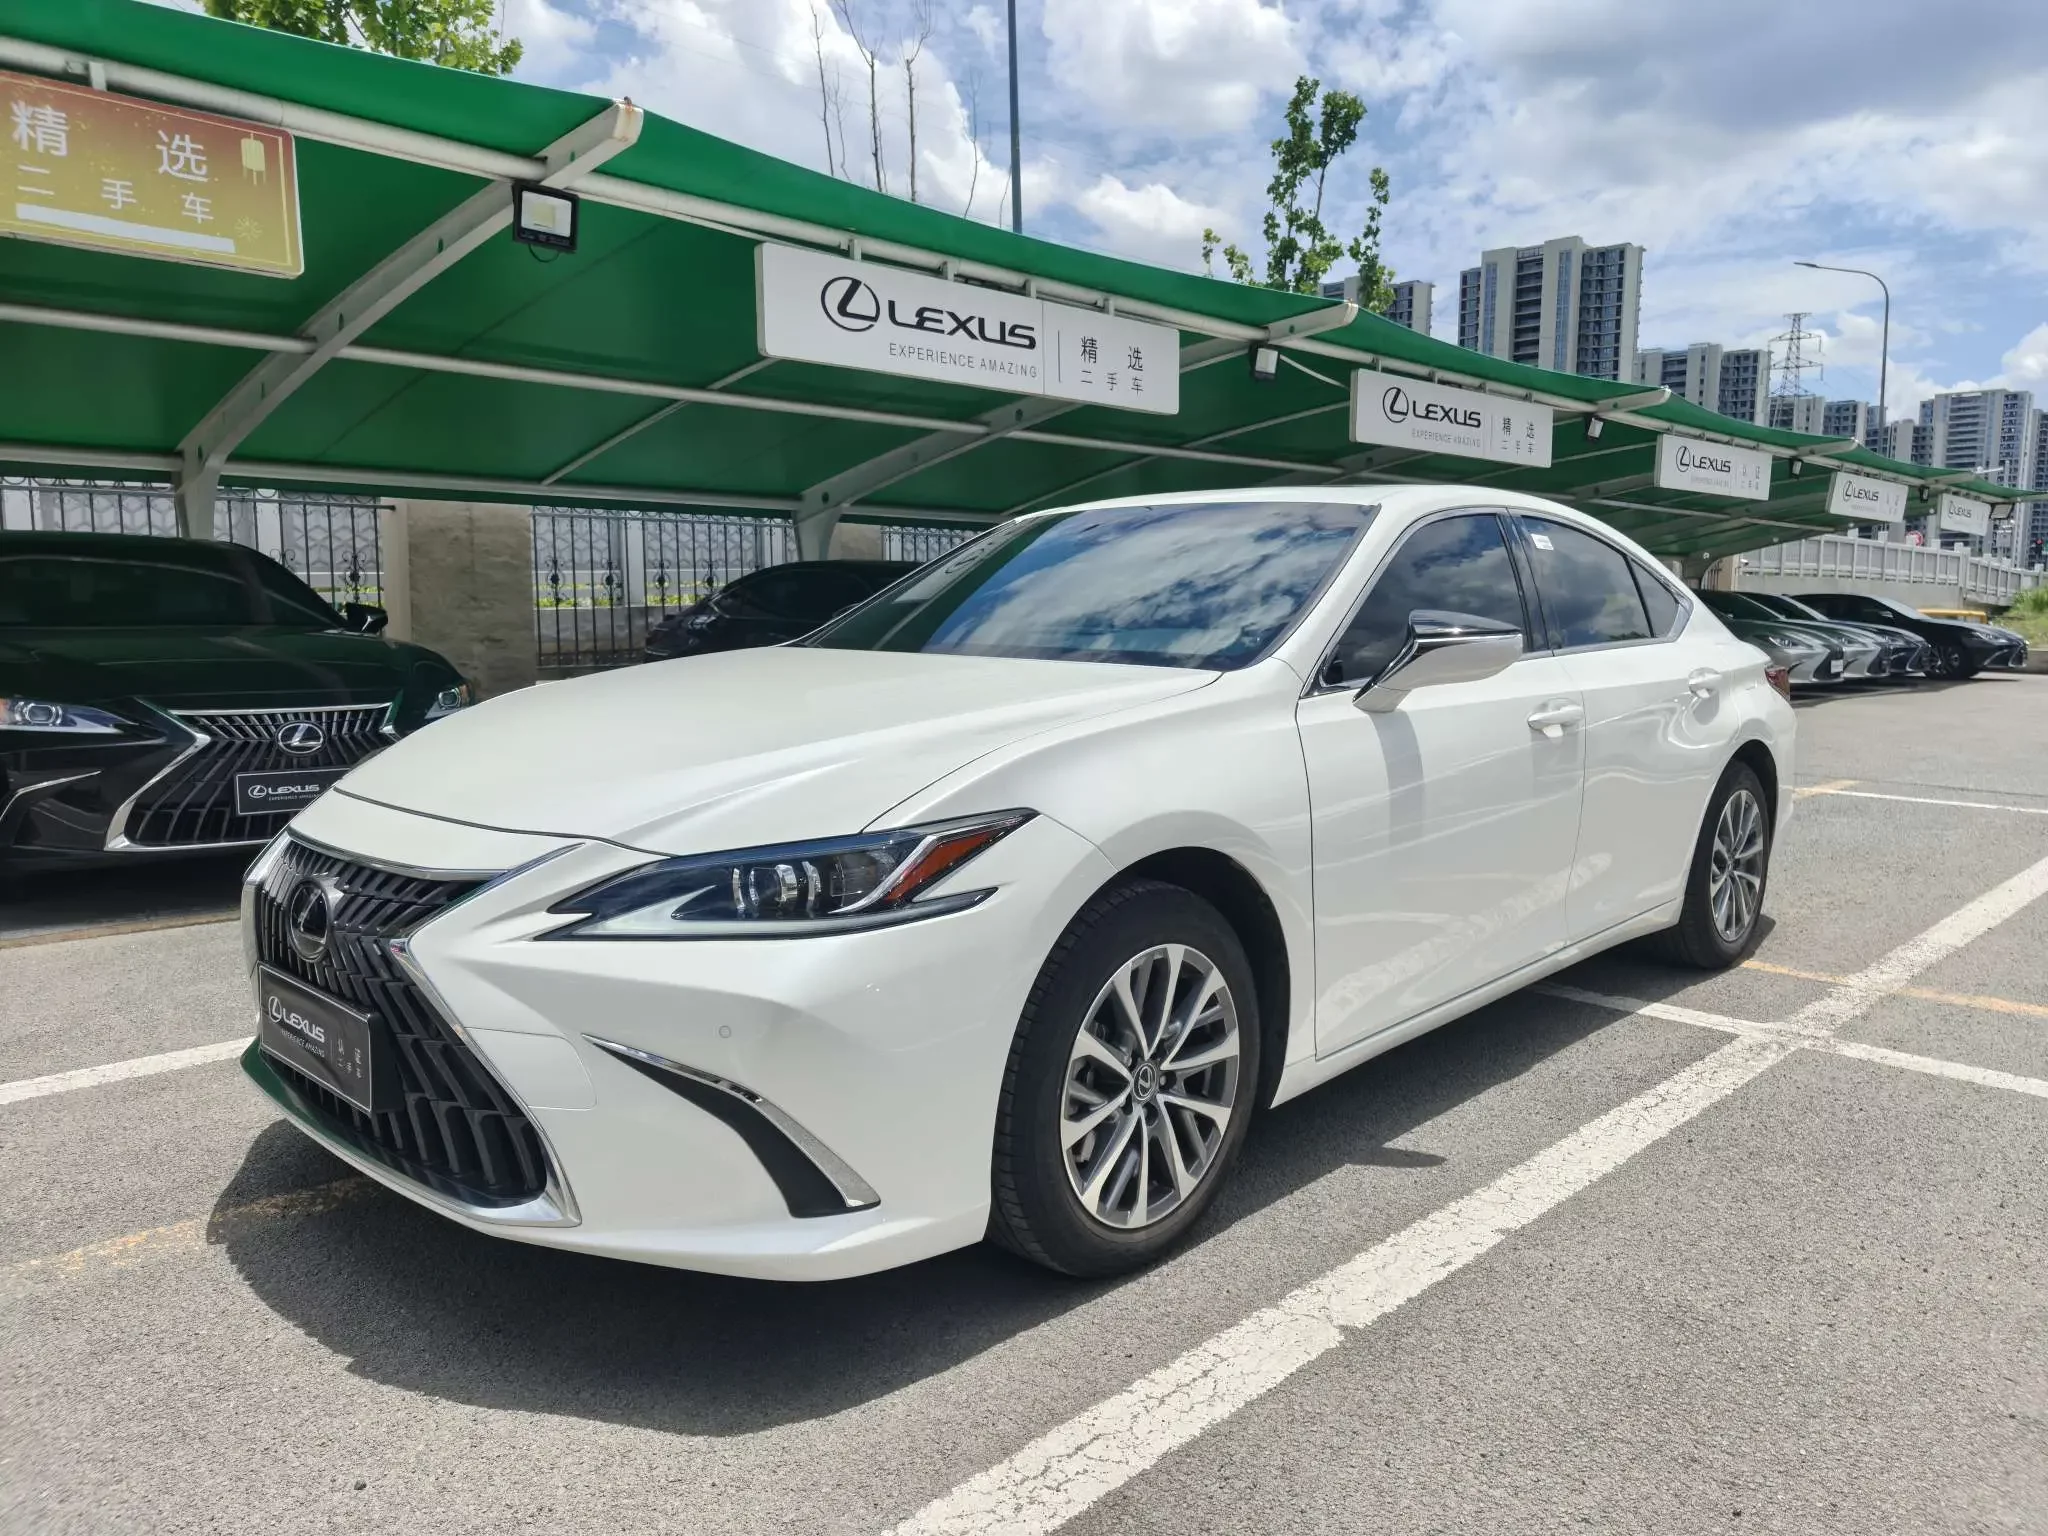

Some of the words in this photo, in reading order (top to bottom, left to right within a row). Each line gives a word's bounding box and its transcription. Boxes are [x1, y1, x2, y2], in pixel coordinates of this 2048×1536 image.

[10, 99, 208, 182] 精选
[17, 164, 214, 224] 二手车
[888, 299, 1036, 350] LEXUS
[889, 342, 975, 369] EXPERIENCE
[980, 357, 1038, 378] AMAZING
[1080, 336, 1143, 371] 精选
[1080, 370, 1144, 396] 二手车
[1412, 400, 1481, 428] LEXUS
[1692, 453, 1731, 473] LEXUS
[1853, 486, 1879, 501] LEXUS
[268, 784, 320, 795] LEXUS
[283, 1007, 325, 1043] LEXUS
